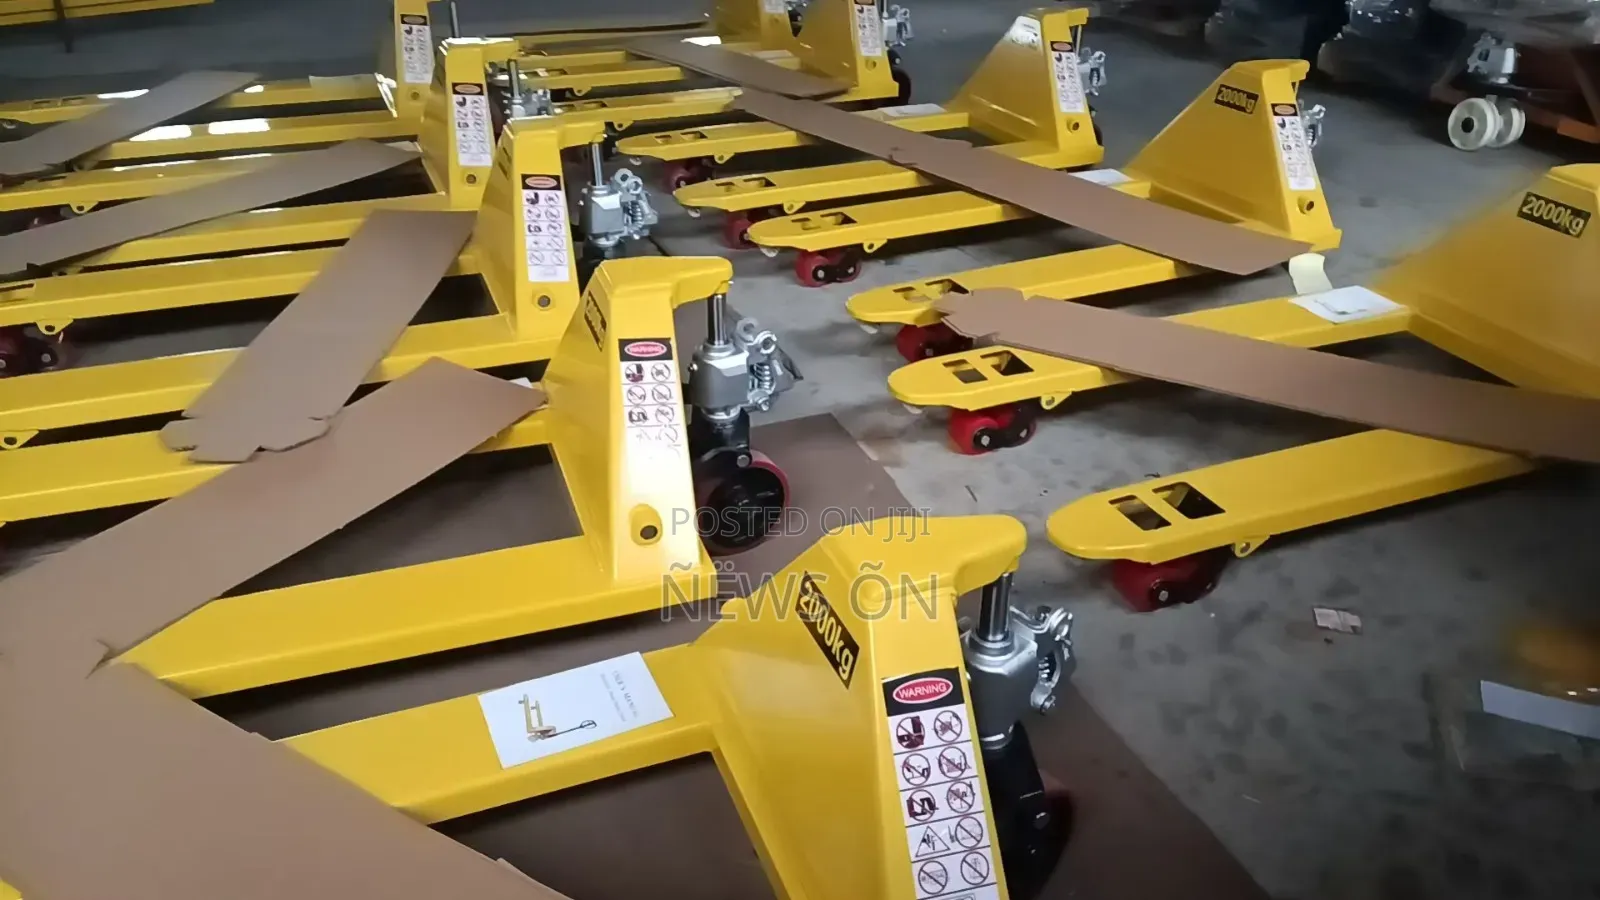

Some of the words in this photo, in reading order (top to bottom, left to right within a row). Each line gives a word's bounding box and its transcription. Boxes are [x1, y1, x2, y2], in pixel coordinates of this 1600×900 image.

[1521, 195, 1585, 236] 2000kg
[799, 580, 854, 681] 2000kg
[898, 682, 948, 699] WARNING
